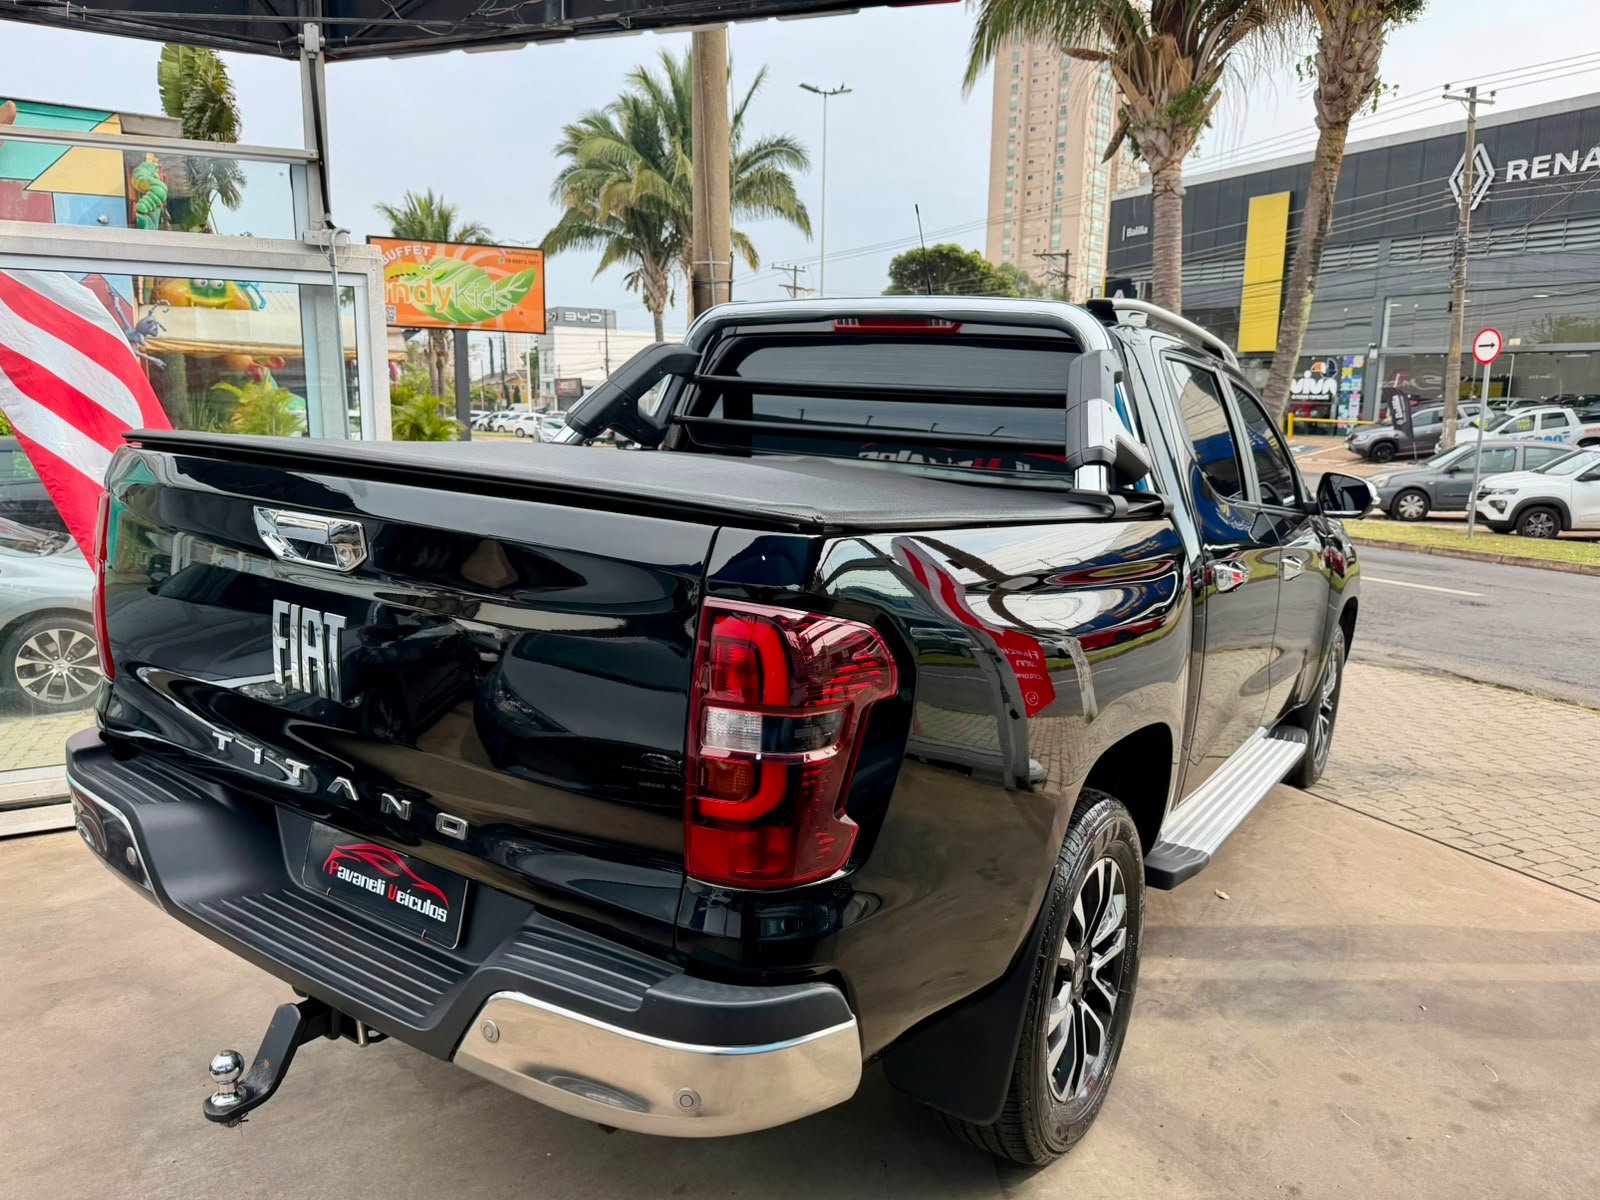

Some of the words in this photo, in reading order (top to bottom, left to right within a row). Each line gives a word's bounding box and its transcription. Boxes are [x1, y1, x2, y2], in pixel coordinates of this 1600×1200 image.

[1505, 146, 1600, 183] RENA
[381, 245, 432, 265] BUFFET
[564, 311, 602, 323] BYD
[272, 598, 348, 703] FIAT
[211, 730, 470, 841] TITANO
[328, 860, 386, 896] Pavaneli
[387, 883, 448, 923] Veículos
